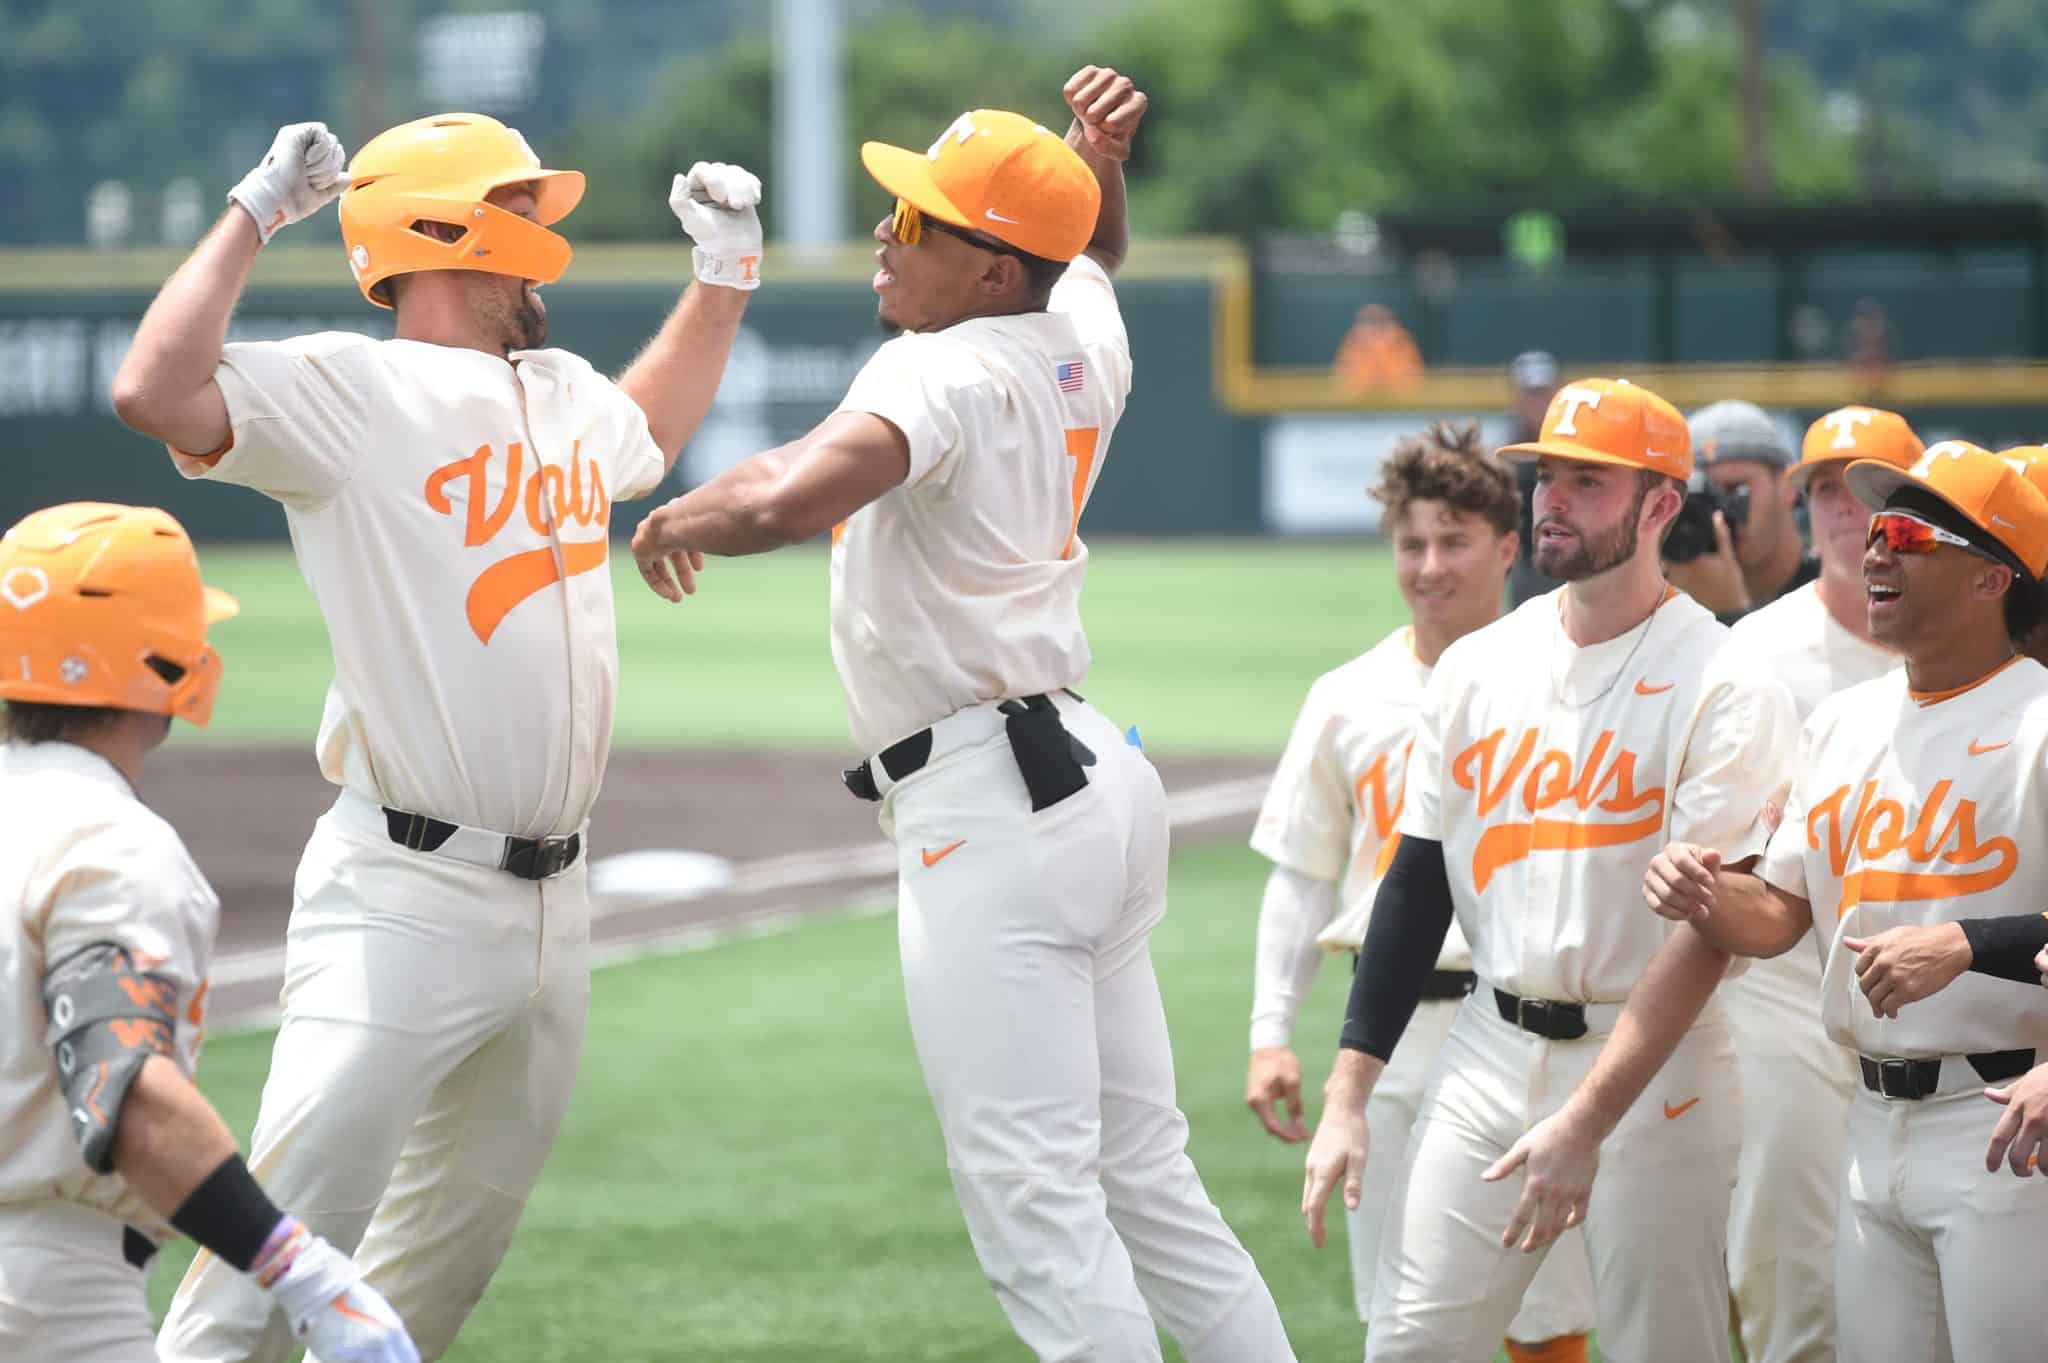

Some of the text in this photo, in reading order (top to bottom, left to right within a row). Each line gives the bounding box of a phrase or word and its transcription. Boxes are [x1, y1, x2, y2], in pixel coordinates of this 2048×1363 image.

[739, 255, 758, 281] T
[1552, 386, 1601, 435] T
[1824, 408, 1872, 449] T
[425, 439, 609, 547] Vols
[1452, 727, 1665, 818] Vols
[1807, 779, 2018, 877] Vols
